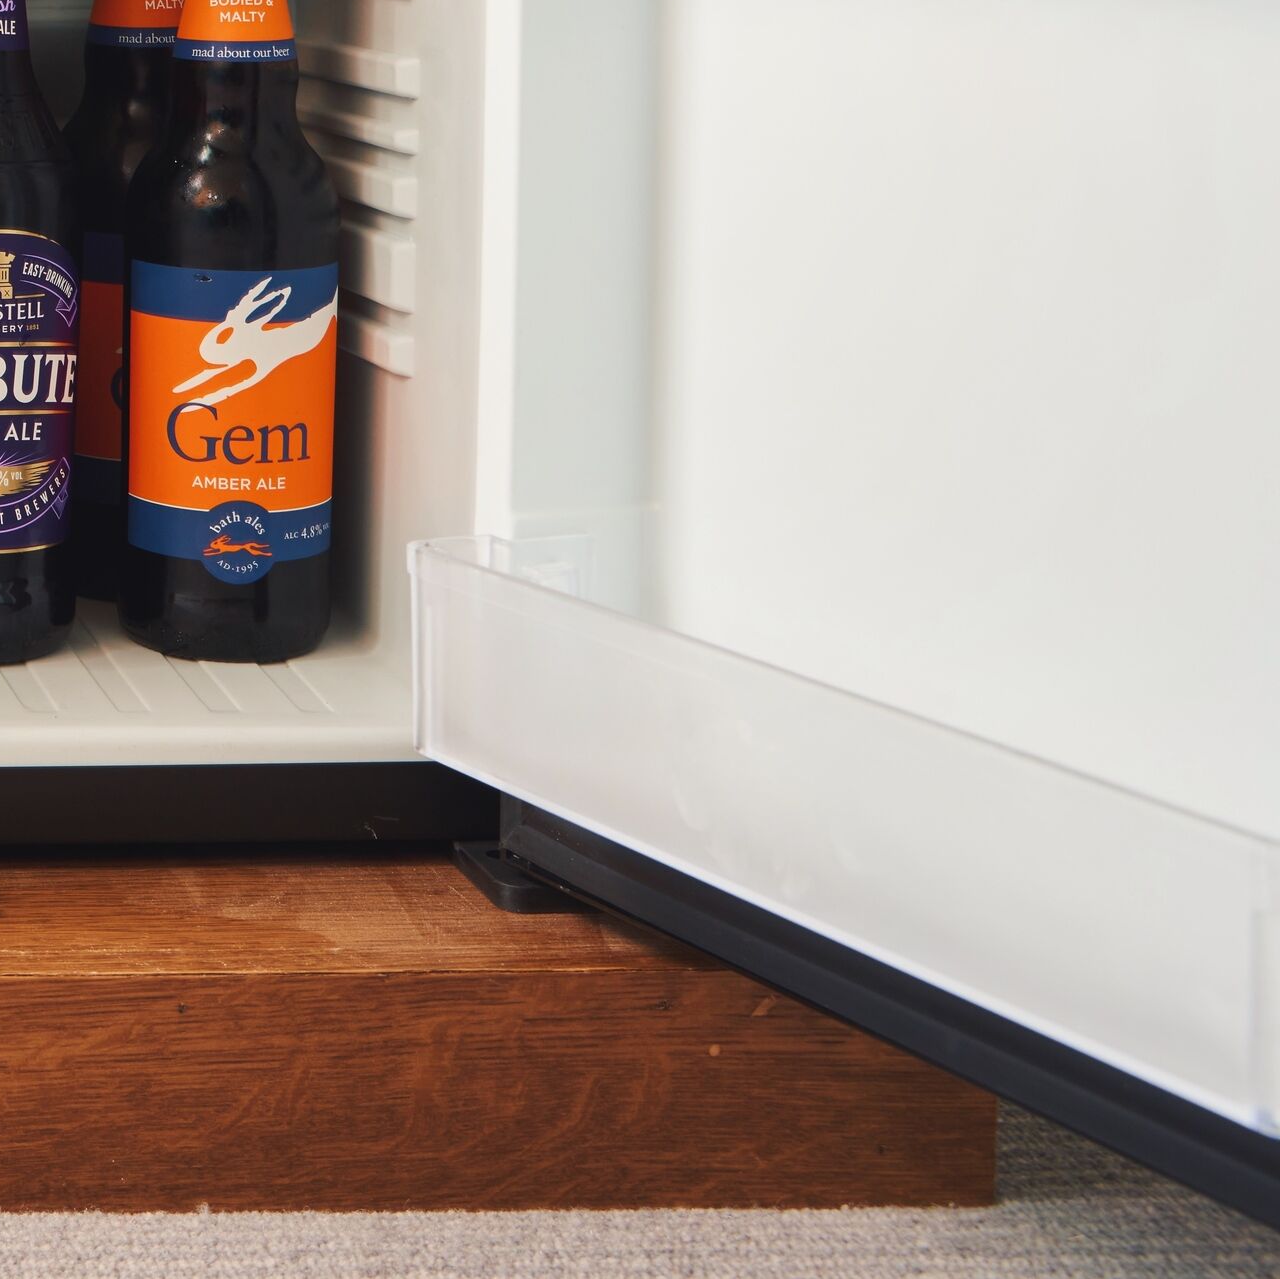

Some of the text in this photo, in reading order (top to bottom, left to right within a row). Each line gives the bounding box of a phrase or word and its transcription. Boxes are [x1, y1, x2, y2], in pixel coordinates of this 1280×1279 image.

[145, 0, 184, 10] MALTY
[219, 11, 266, 22] MALTY
[118, 32, 176, 44] mad about
[192, 46, 290, 58] mad about our beer
[22, 262, 74, 299] EASY-DRINKING
[4, 422, 42, 441] ALE
[166, 402, 310, 465] Gem
[10, 471, 23, 480] VOL
[191, 475, 287, 491] AMBER ALE
[15, 468, 66, 521] BREWERS
[209, 511, 266, 535] bath ales
[284, 531, 299, 540] ALC
[300, 523, 323, 539] 4.8%
